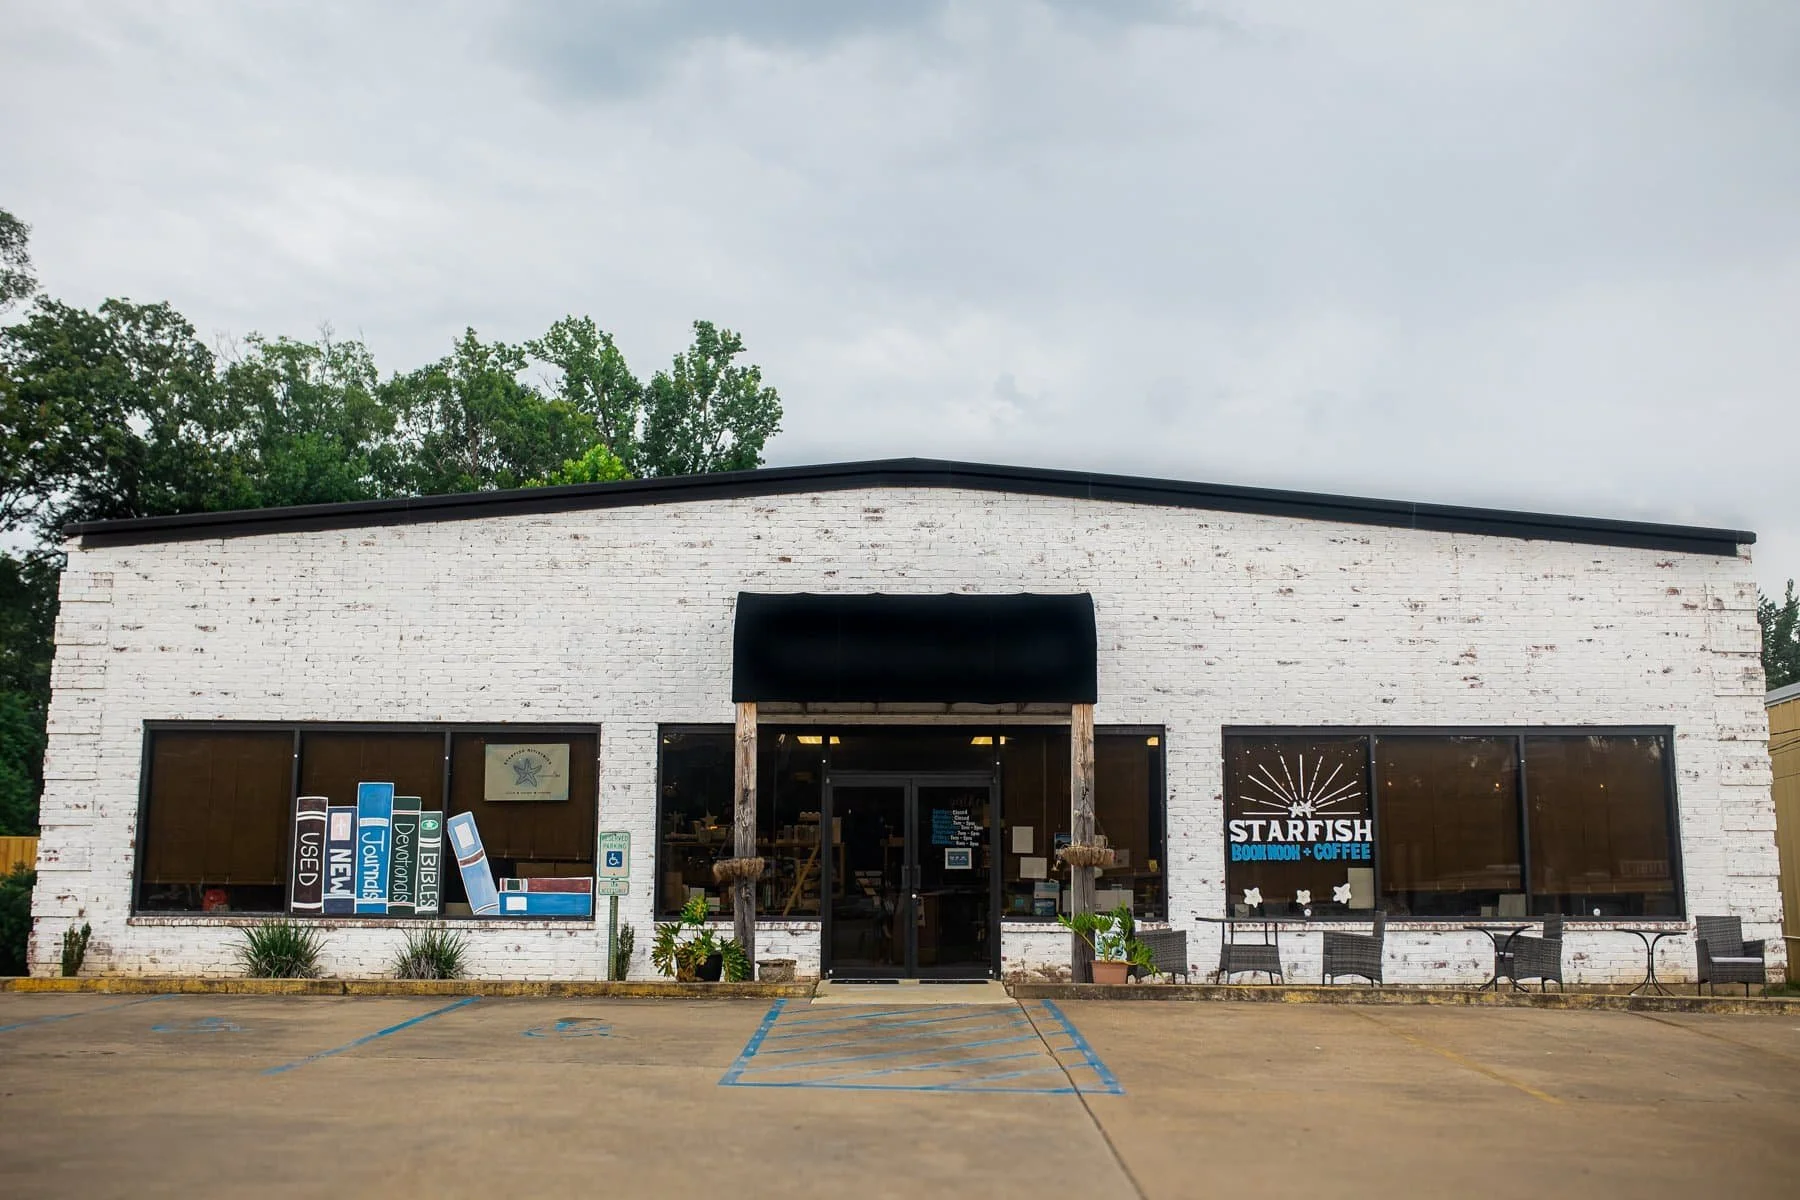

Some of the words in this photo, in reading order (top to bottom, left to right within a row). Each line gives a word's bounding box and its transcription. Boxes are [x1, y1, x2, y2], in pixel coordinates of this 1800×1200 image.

[601, 834, 629, 842] RESERVED
[1228, 819, 1373, 842] STARFISH
[1313, 843, 1371, 860] COFFEE
[298, 831, 320, 886] USED
[329, 848, 352, 894] NEW
[361, 831, 385, 900] Journals
[393, 823, 416, 904] Devotionals
[420, 852, 438, 911] BIBLES
